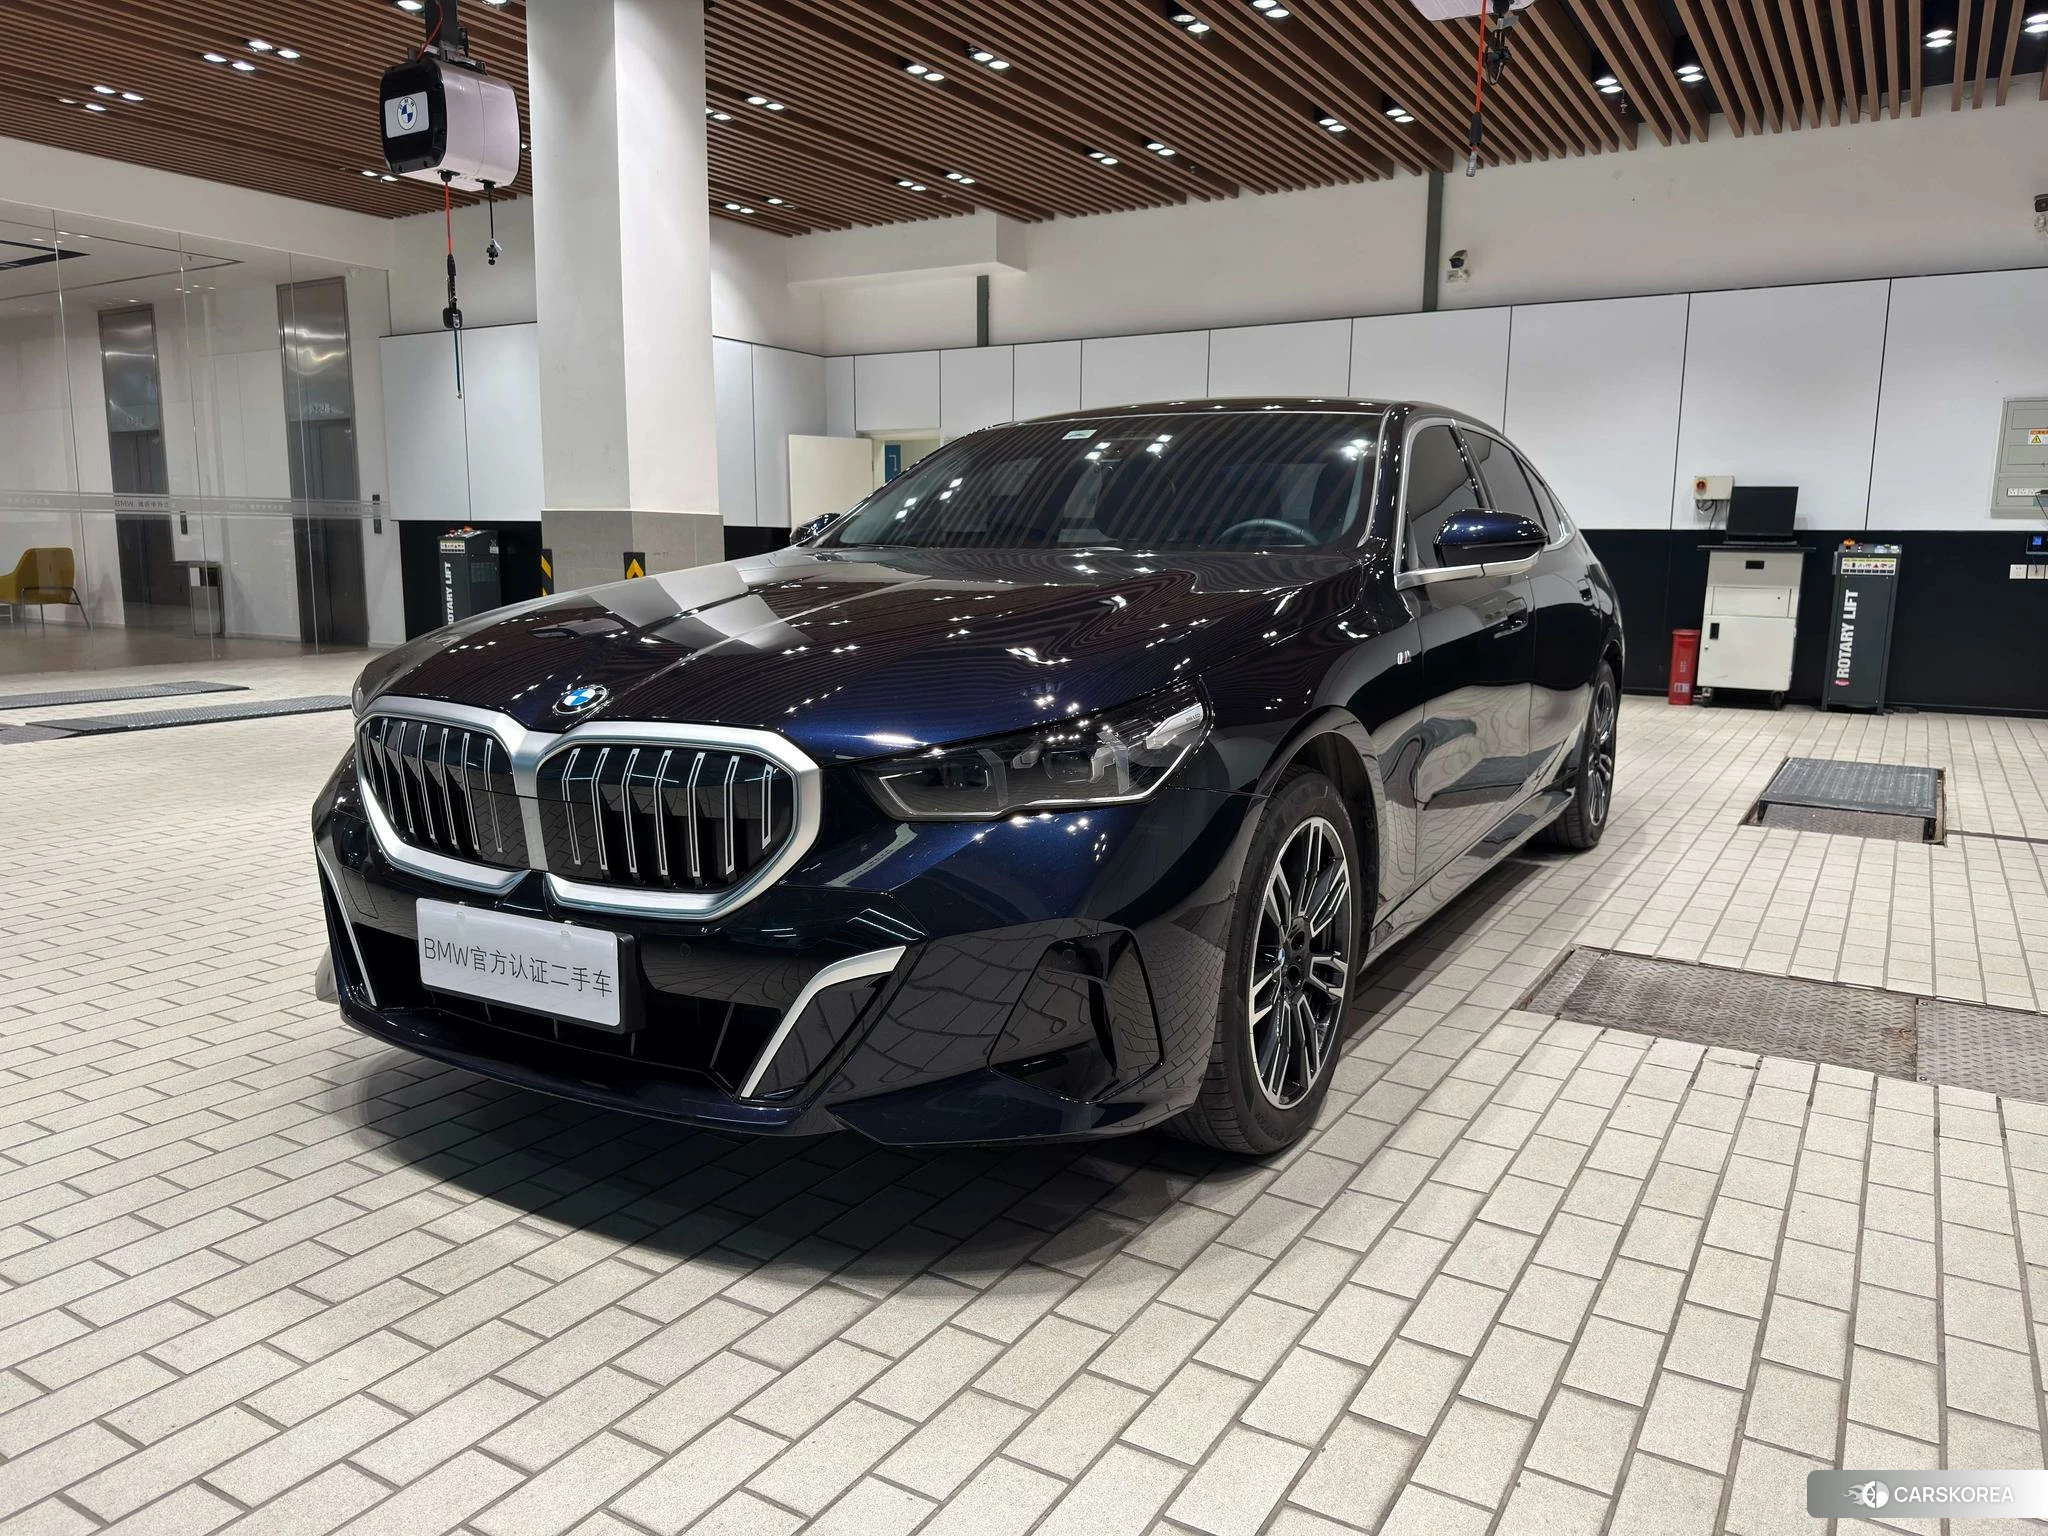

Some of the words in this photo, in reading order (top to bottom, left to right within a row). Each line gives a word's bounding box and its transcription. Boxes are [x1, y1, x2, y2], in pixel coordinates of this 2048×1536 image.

[444, 561, 453, 585] LIFT
[444, 587, 455, 625] OTARY
[1842, 589, 1859, 619] LIFT
[1836, 622, 1855, 678] ROTARY
[424, 938, 612, 998] BMW官方认证二手车
